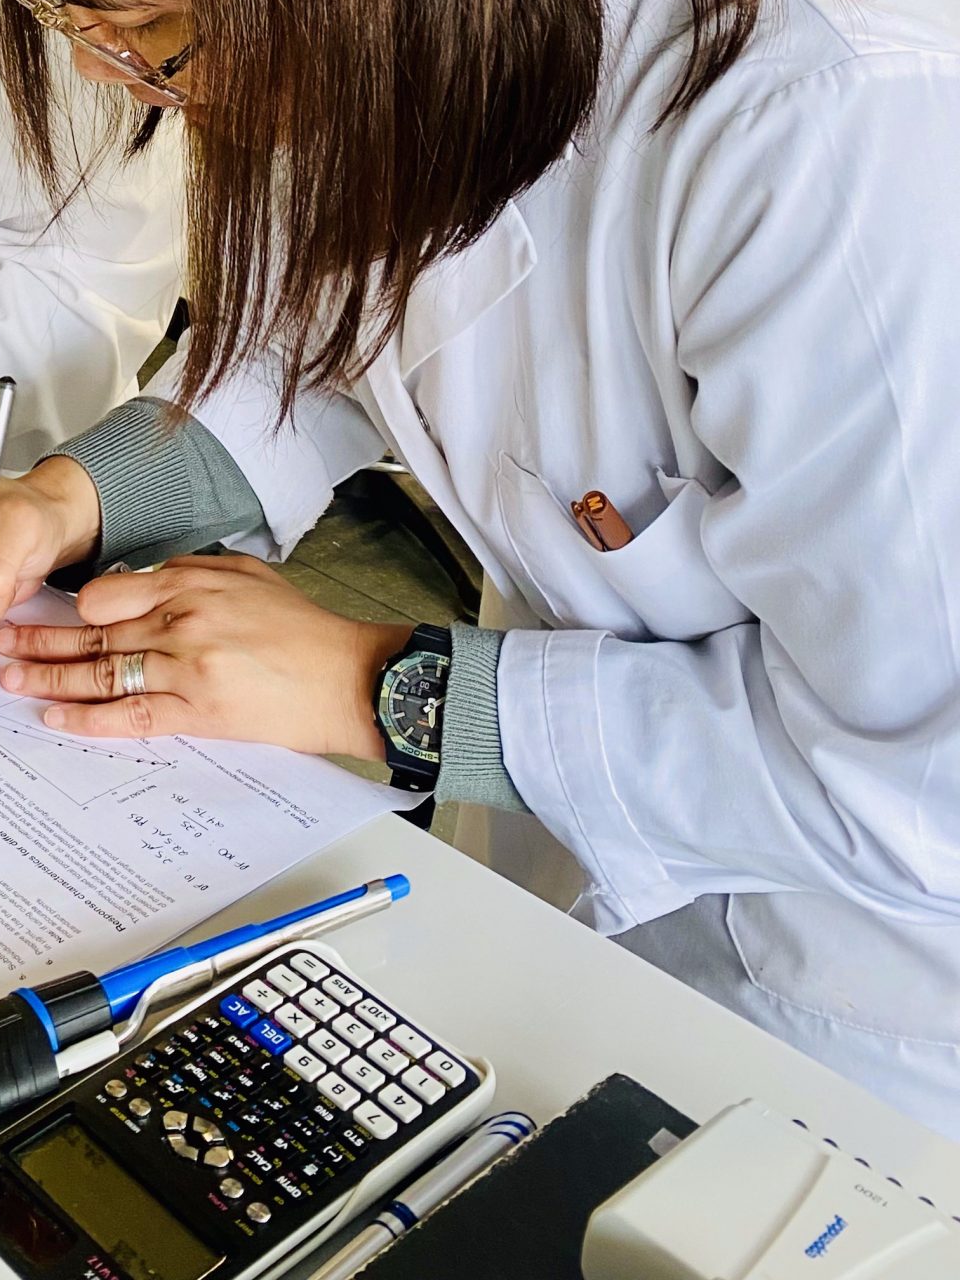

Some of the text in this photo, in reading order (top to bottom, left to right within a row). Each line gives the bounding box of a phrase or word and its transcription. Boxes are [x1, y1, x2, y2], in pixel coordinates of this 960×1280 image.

[401, 744, 440, 763] -SHOCK
[16, 846, 30, 857] for
[29, 855, 85, 900] characteristics
[84, 900, 126, 932] Response
[48, 930, 65, 944] Note:
[332, 979, 355, 995] Ans
[228, 1000, 251, 1016] AC
[257, 1023, 284, 1045] DEL
[346, 1023, 361, 1034] 3
[183, 1029, 198, 1043] tan
[322, 1039, 336, 1050] 6
[209, 1051, 225, 1064] cos
[298, 1055, 313, 1067] 9
[381, 1049, 396, 1061] 2
[356, 1066, 371, 1078] 5
[439, 1060, 454, 1071] 0
[238, 1074, 253, 1087] sin
[418, 1077, 429, 1087] 1
[331, 1083, 346, 1095] 8
[393, 1095, 406, 1105] 4
[314, 1105, 334, 1121] ENG
[366, 1114, 381, 1125] 7
[343, 1129, 364, 1147] STO
[246, 1150, 272, 1171] CALC
[276, 1176, 302, 1198] OPTN
[235, 1219, 254, 1236] SHIFT
